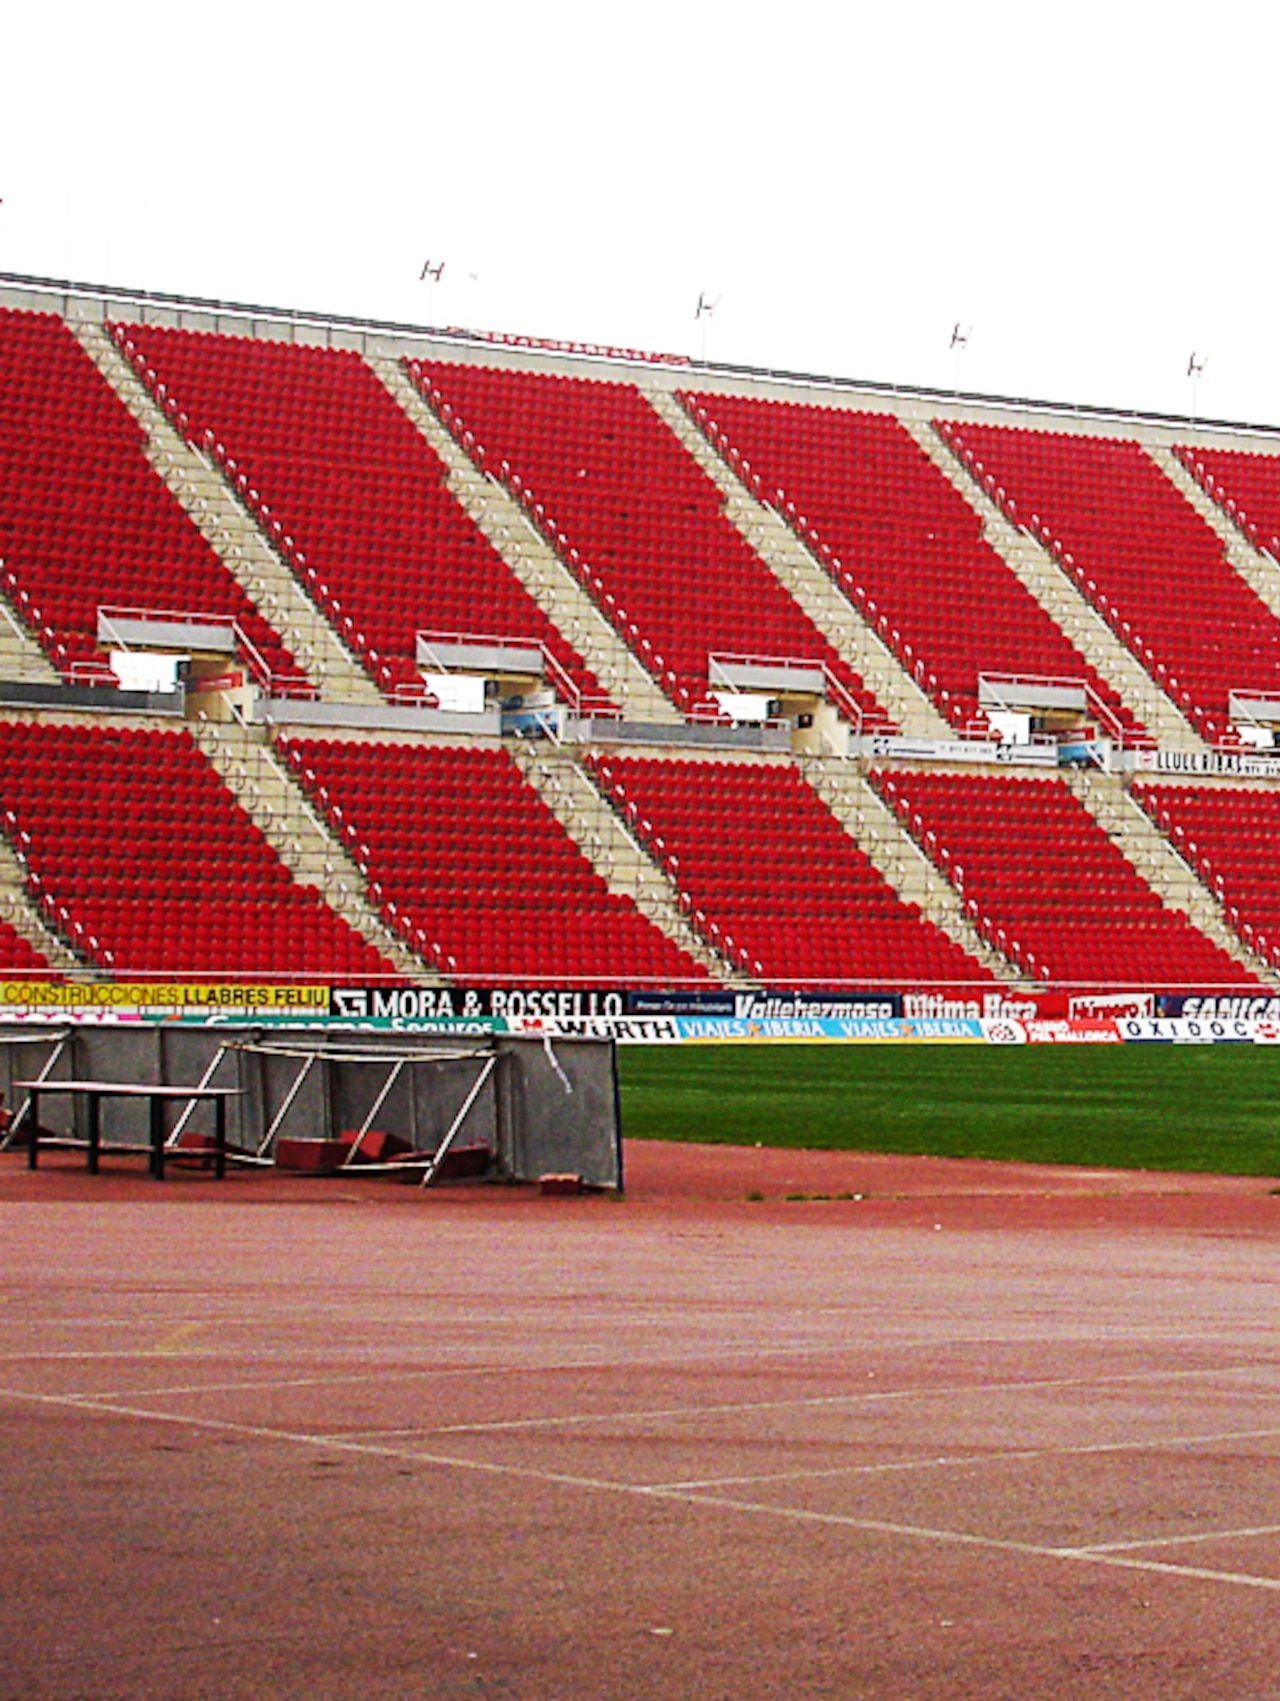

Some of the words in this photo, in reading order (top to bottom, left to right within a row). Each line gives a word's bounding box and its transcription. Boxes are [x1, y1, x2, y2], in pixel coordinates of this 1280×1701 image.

[5, 986, 178, 1003] CONSTRUCCIONES
[184, 988, 267, 1005] LLABRES
[275, 989, 325, 1005] FELIU
[373, 990, 452, 1017] MORA
[463, 991, 483, 1017] &
[493, 992, 623, 1017] ROSSELLO
[734, 992, 893, 1019] Vallehermoso
[983, 993, 1038, 1019] Hora
[556, 1021, 675, 1039] WÜRTH
[682, 1020, 744, 1038] VIAJES
[762, 1020, 825, 1037] IBERIA
[840, 1021, 899, 1039] VIAJES
[914, 1021, 974, 1037] IBERIA
